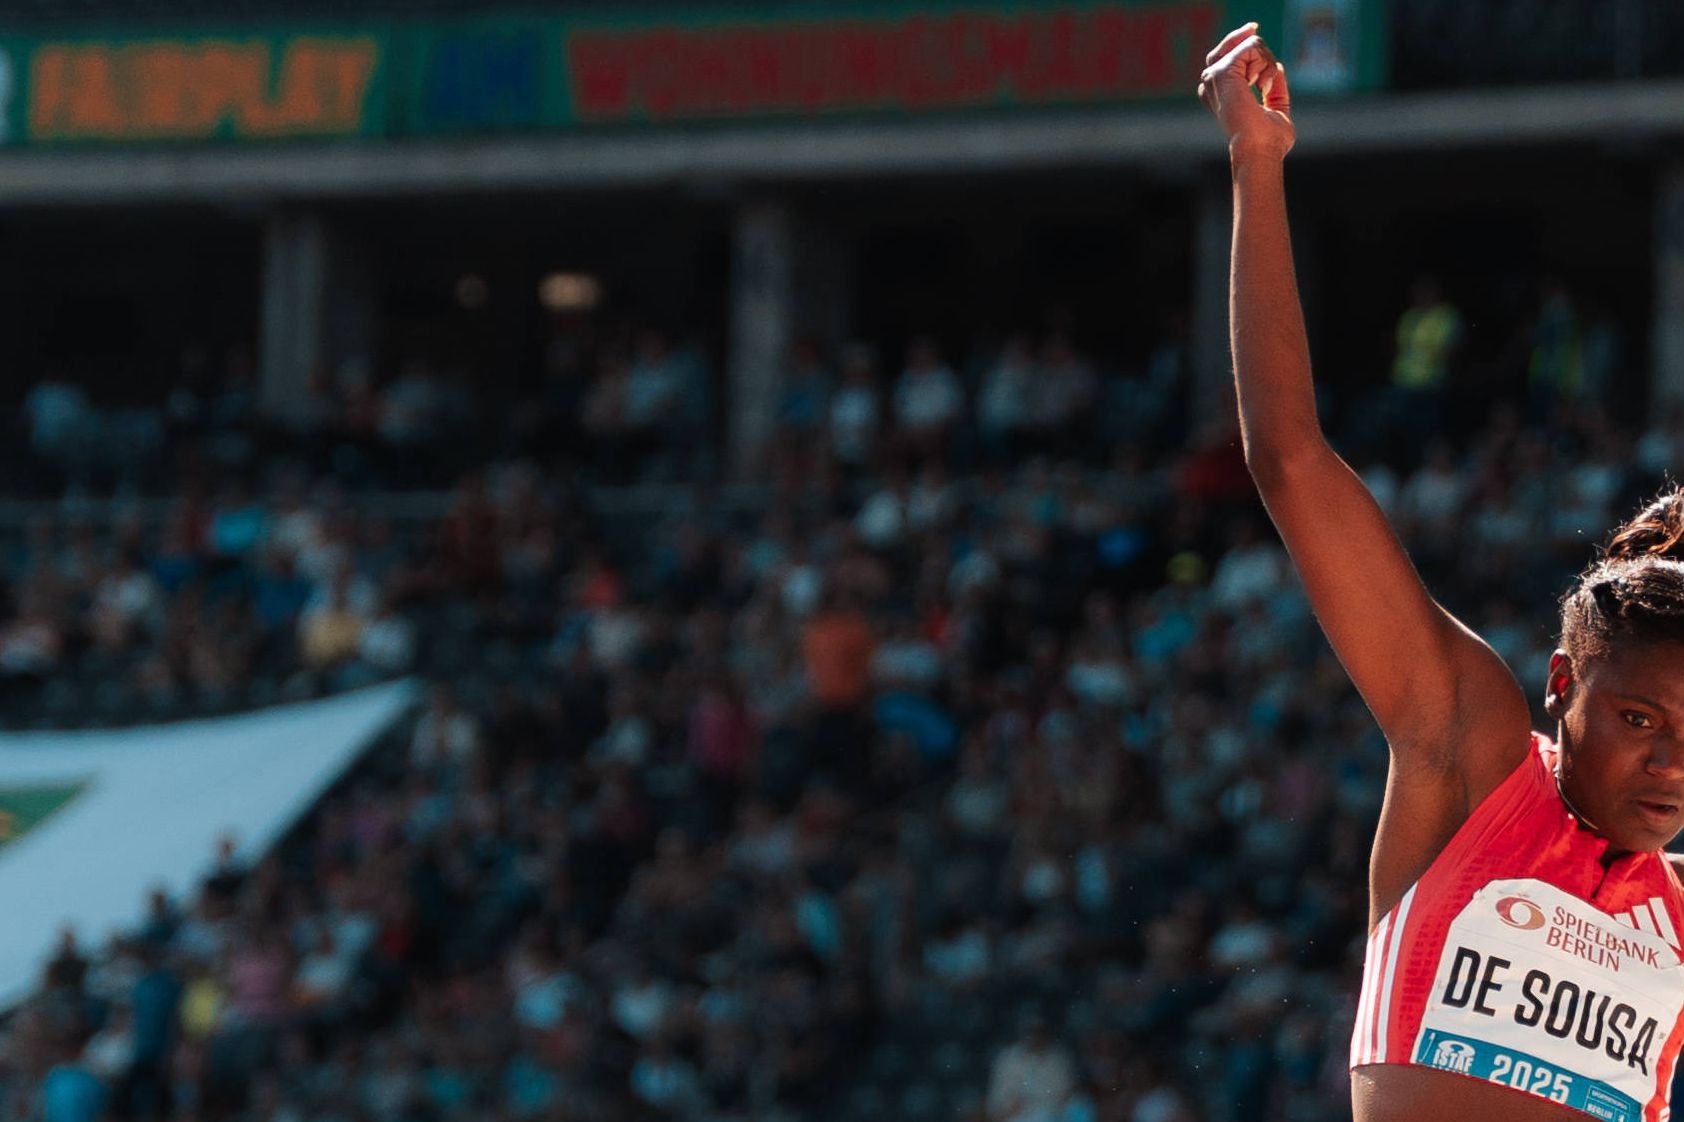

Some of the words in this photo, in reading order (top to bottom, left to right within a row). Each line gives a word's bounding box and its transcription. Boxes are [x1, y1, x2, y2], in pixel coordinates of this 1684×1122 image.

[1546, 927, 1620, 971] BERLIN
[1552, 905, 1659, 968] SPIELBANK
[1441, 946, 1511, 1016] DE
[1513, 968, 1659, 1076] SOUSA
[1433, 1048, 1475, 1073] ISTAF
[1489, 1054, 1573, 1104] 2025
